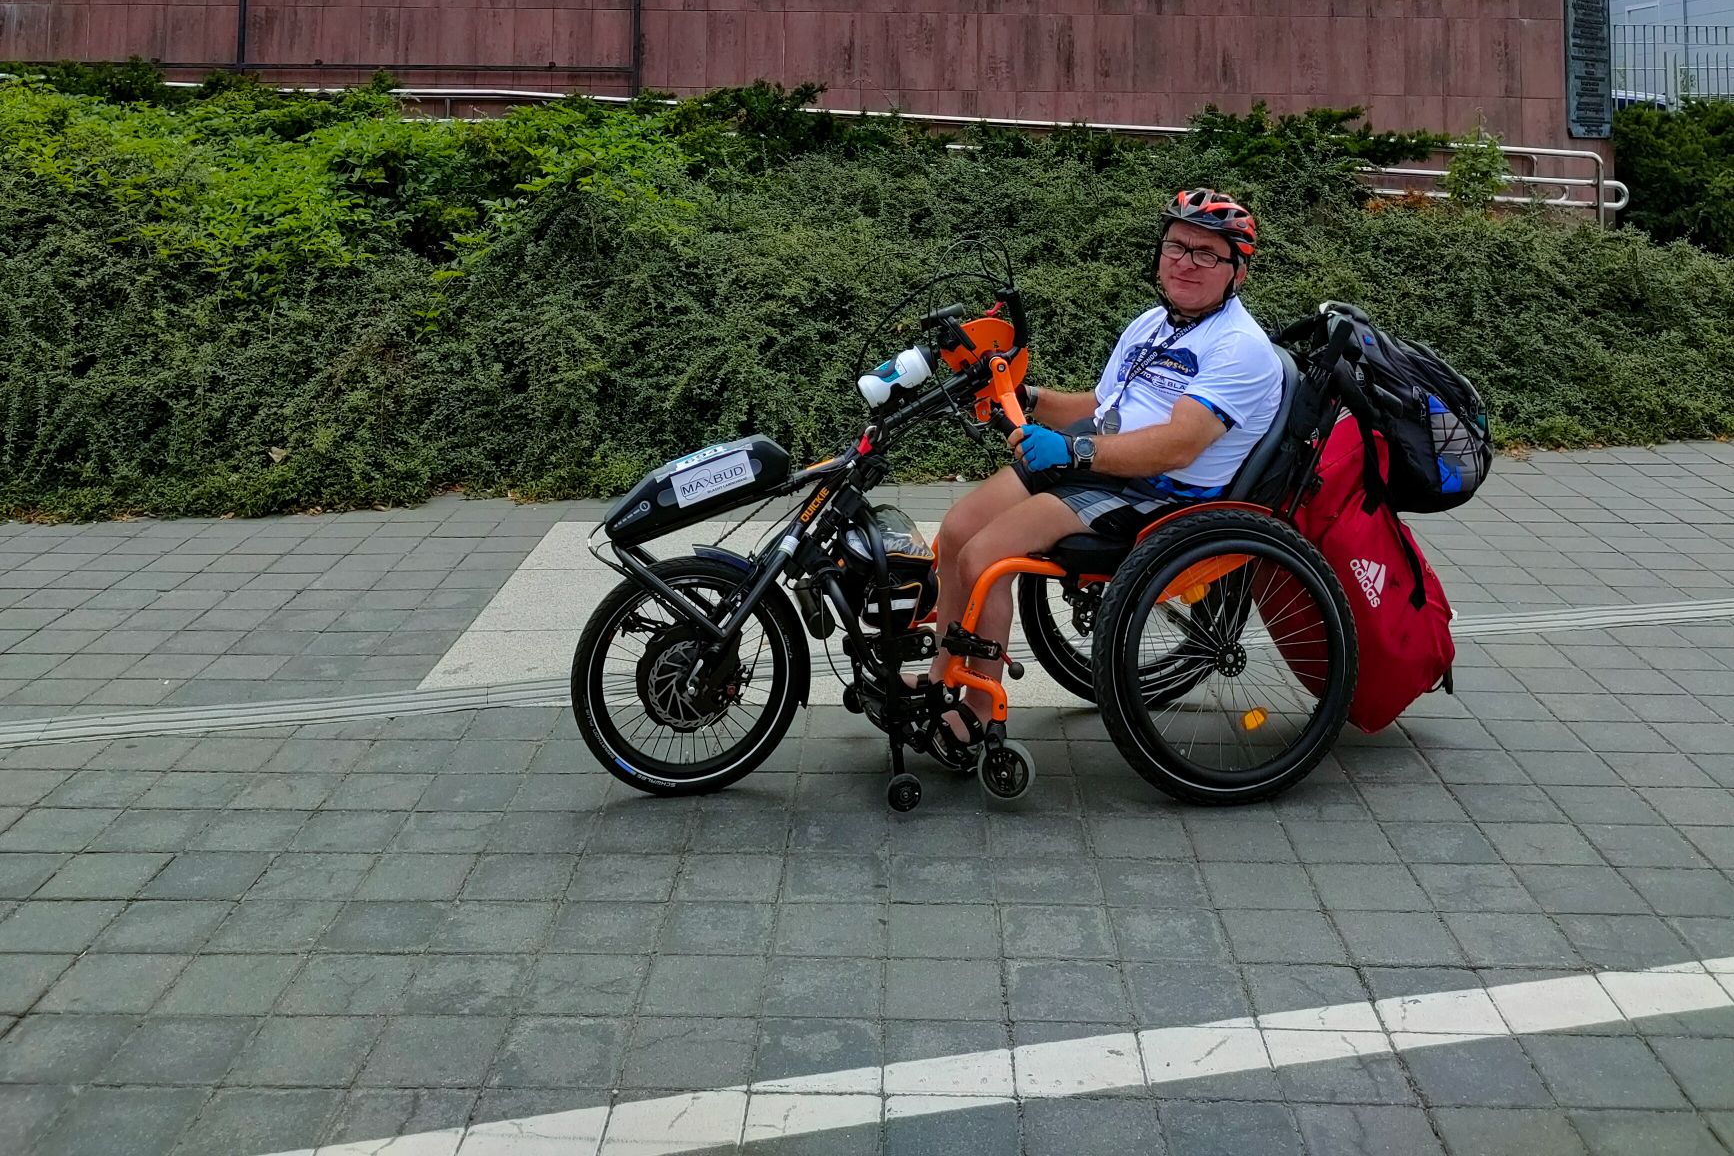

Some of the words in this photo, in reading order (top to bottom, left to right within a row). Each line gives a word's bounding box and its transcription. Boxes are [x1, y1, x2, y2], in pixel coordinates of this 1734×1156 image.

[1141, 351, 1158, 369] FONDO
[1167, 381, 1186, 390] BLA
[682, 466, 744, 495] MAXBUD
[800, 486, 829, 522] QUICKIE
[1350, 558, 1381, 608] adidas
